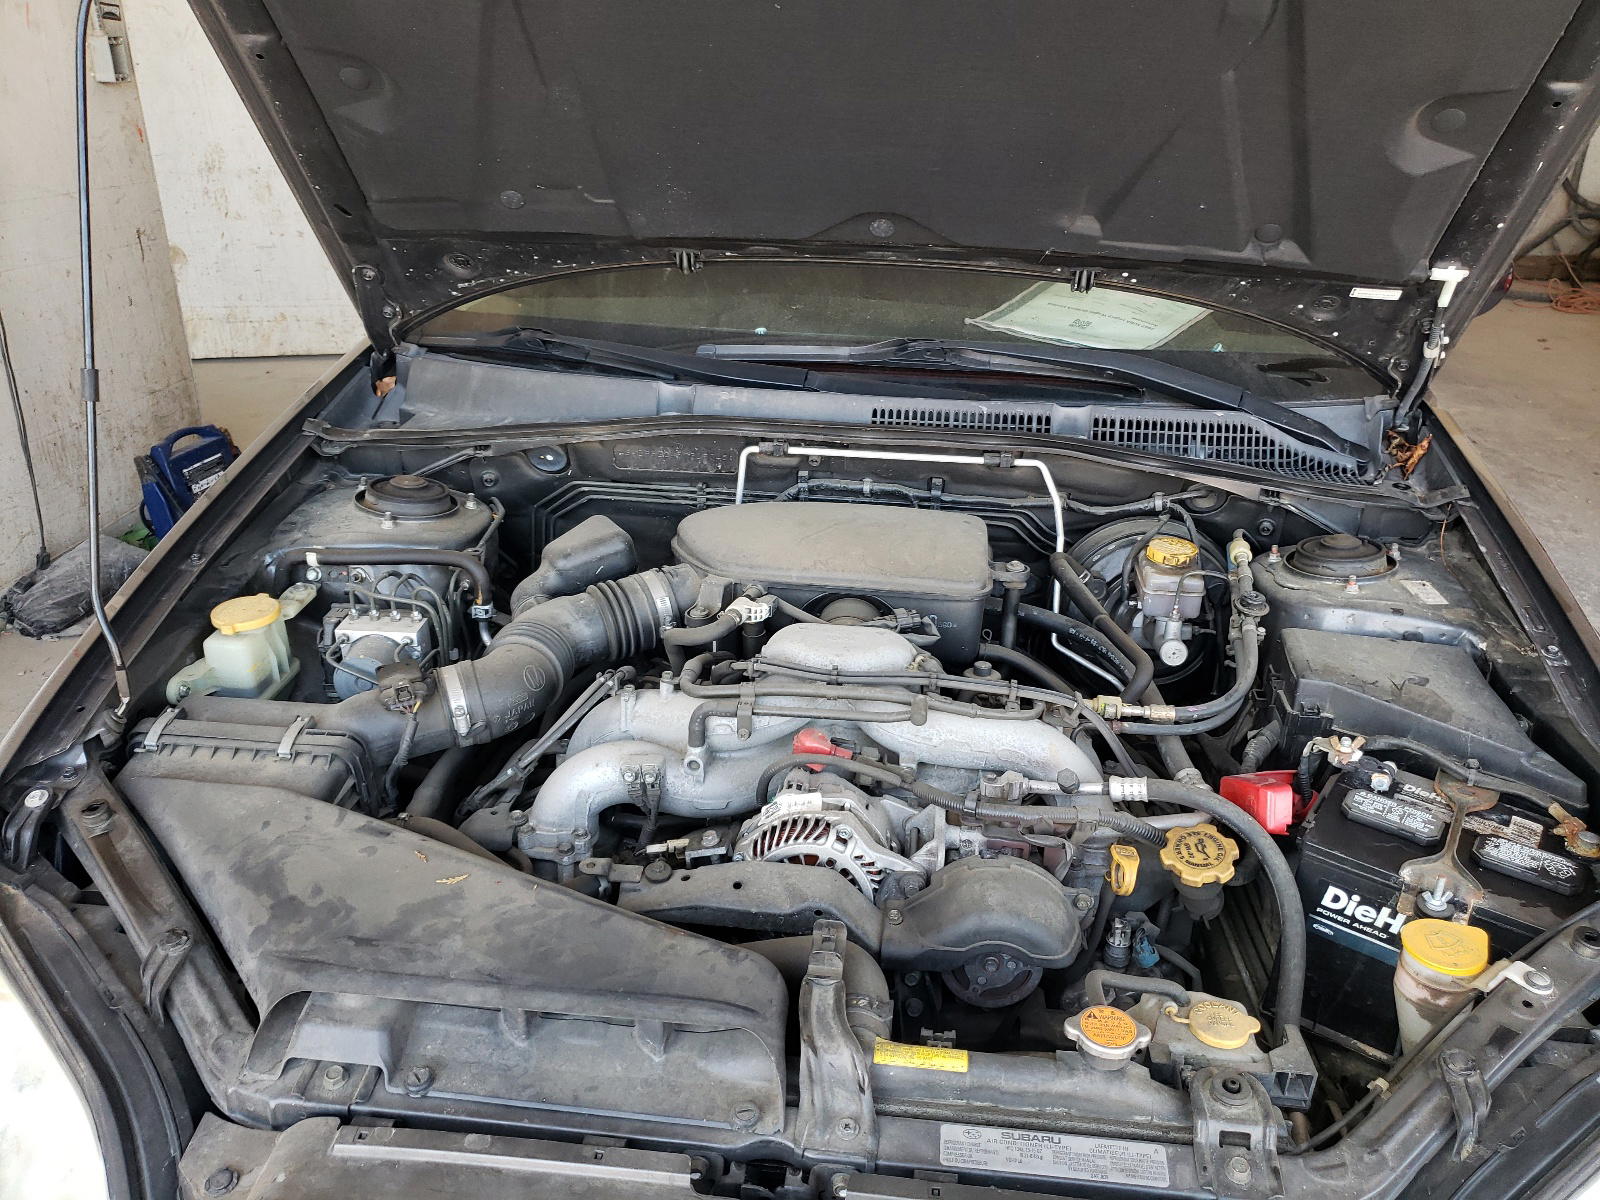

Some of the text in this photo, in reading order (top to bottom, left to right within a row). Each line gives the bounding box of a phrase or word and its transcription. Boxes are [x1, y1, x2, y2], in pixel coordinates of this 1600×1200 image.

[1316, 907, 1351, 925] POWER
[1352, 922, 1388, 939] AHEAD
[1193, 1001, 1241, 1017] COOLANT
[1001, 1131, 1062, 1144] SUBARU
